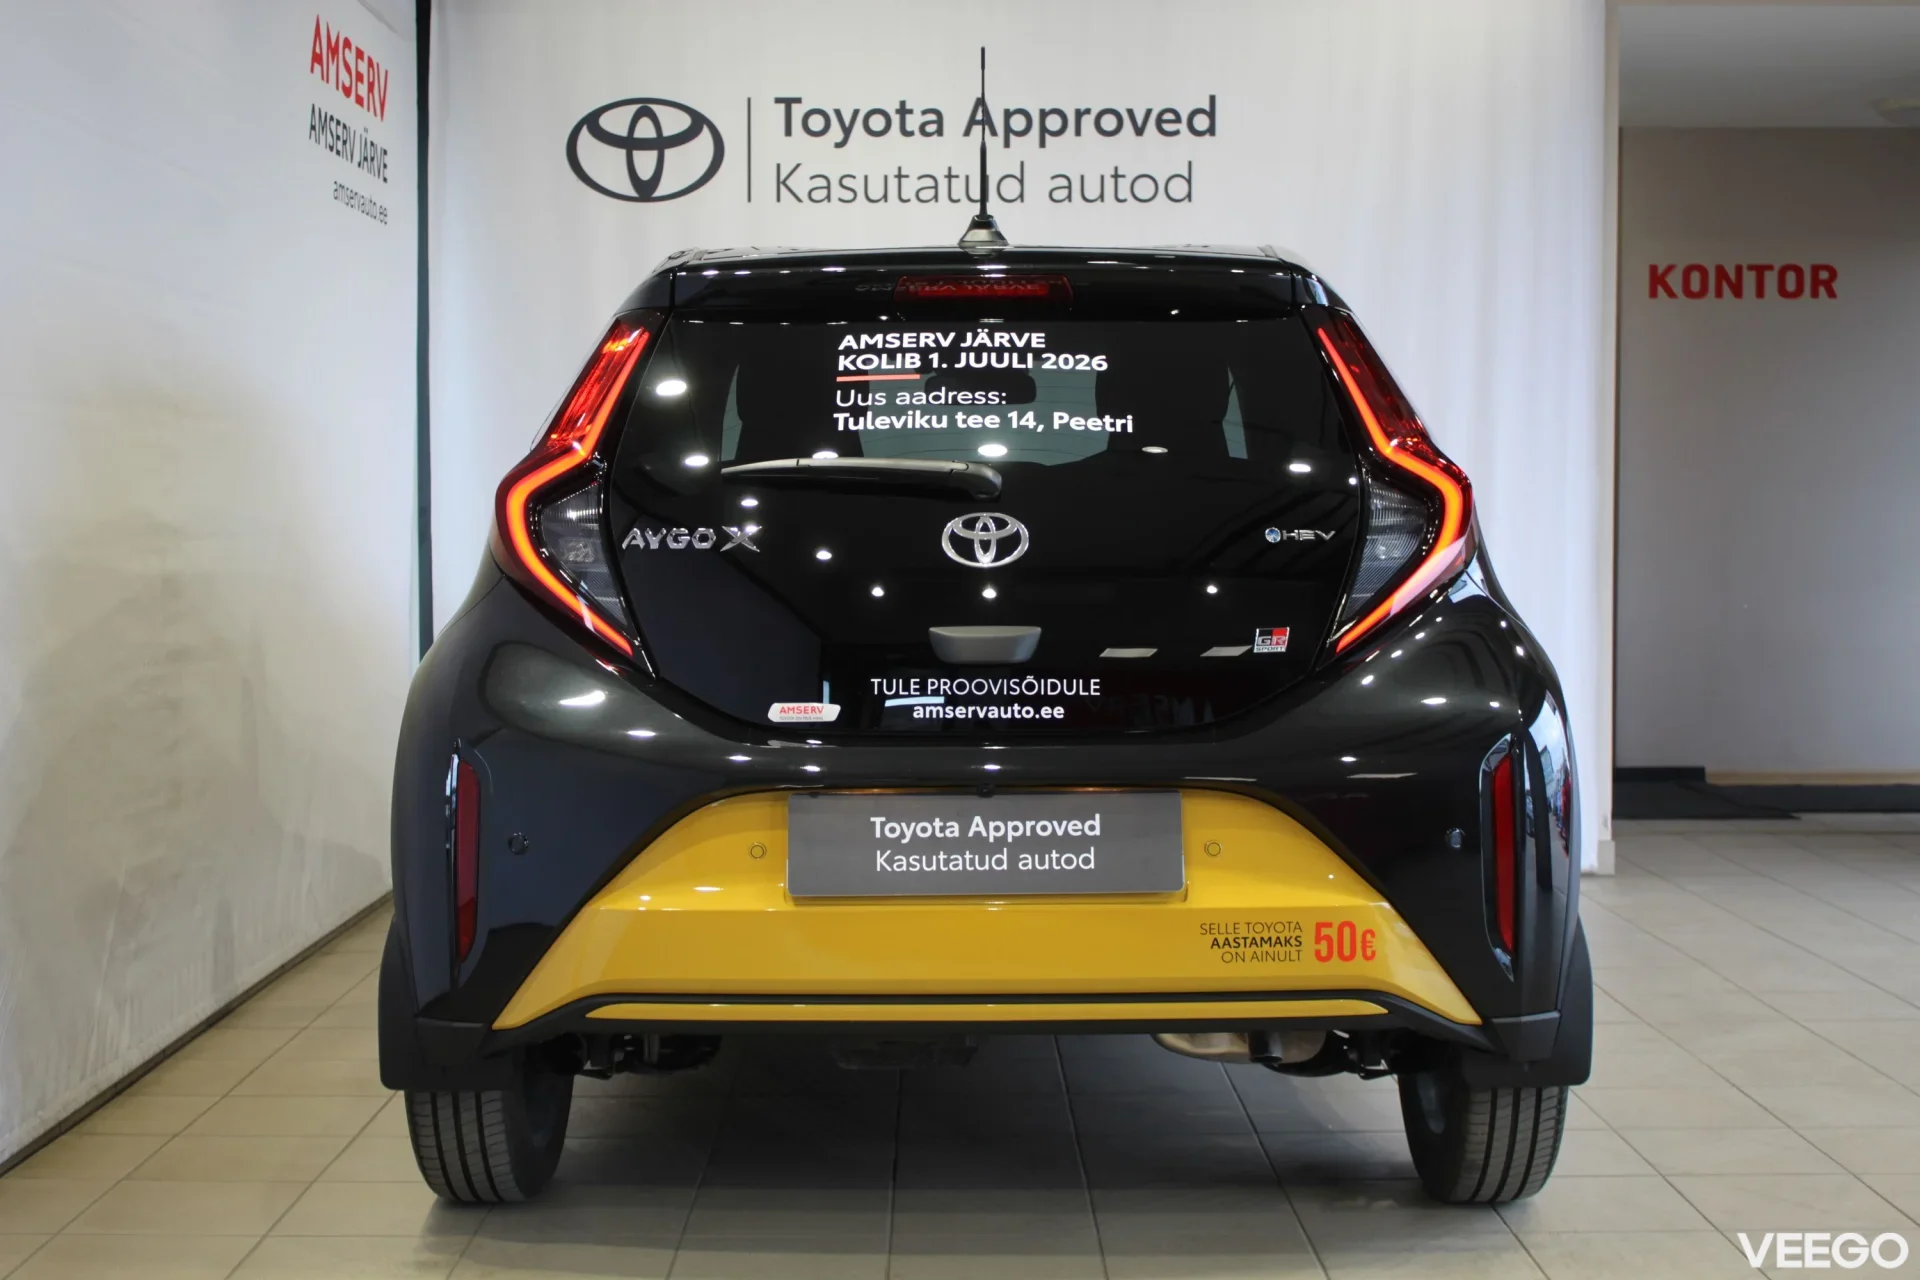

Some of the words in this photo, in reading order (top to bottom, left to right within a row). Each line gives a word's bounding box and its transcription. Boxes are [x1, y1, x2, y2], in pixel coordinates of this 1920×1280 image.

[310, 14, 388, 122] AMSERV
[774, 97, 944, 149] Toyota
[962, 94, 1216, 149] Approved
[309, 103, 356, 164] AMSERV
[357, 127, 388, 183] JÄRVE
[776, 160, 1024, 204] Kasutatud
[1048, 160, 1192, 204] autod
[333, 181, 388, 225] amservauto.ee
[1648, 263, 1838, 299] KONTOR
[838, 331, 956, 350] AMSERV
[960, 328, 1046, 348] JÄRVE
[837, 352, 922, 371] KOLIB
[928, 352, 948, 369] 1.
[954, 351, 1034, 369] JUULI
[1041, 353, 1109, 371] 2026
[836, 389, 887, 407] Uus
[895, 386, 1007, 406] aadress:
[833, 410, 948, 431] Tuleviku
[955, 414, 1000, 430] tee
[1007, 410, 1045, 433] 14,
[1053, 412, 1134, 433] Peetri
[621, 527, 717, 550] AYGO
[719, 525, 763, 552] X
[1282, 529, 1336, 541] HEV
[1257, 635, 1287, 646] GR
[871, 678, 920, 695] TULE
[927, 675, 1101, 697] PROOVISÕIDULE
[779, 705, 825, 715] AMSERV
[912, 703, 1065, 720] amservauto.ee
[870, 816, 960, 844] Toyota
[968, 813, 1101, 843] Approved
[876, 848, 1008, 872] Kasutatud
[1018, 847, 1095, 870] autod
[1200, 922, 1240, 935] SELLE
[1245, 921, 1303, 935] TOYOTA
[1211, 936, 1302, 949] AASTAMAKS
[1314, 920, 1376, 963] 50€
[1221, 950, 1246, 963] ON
[1250, 950, 1302, 962] AINULT
